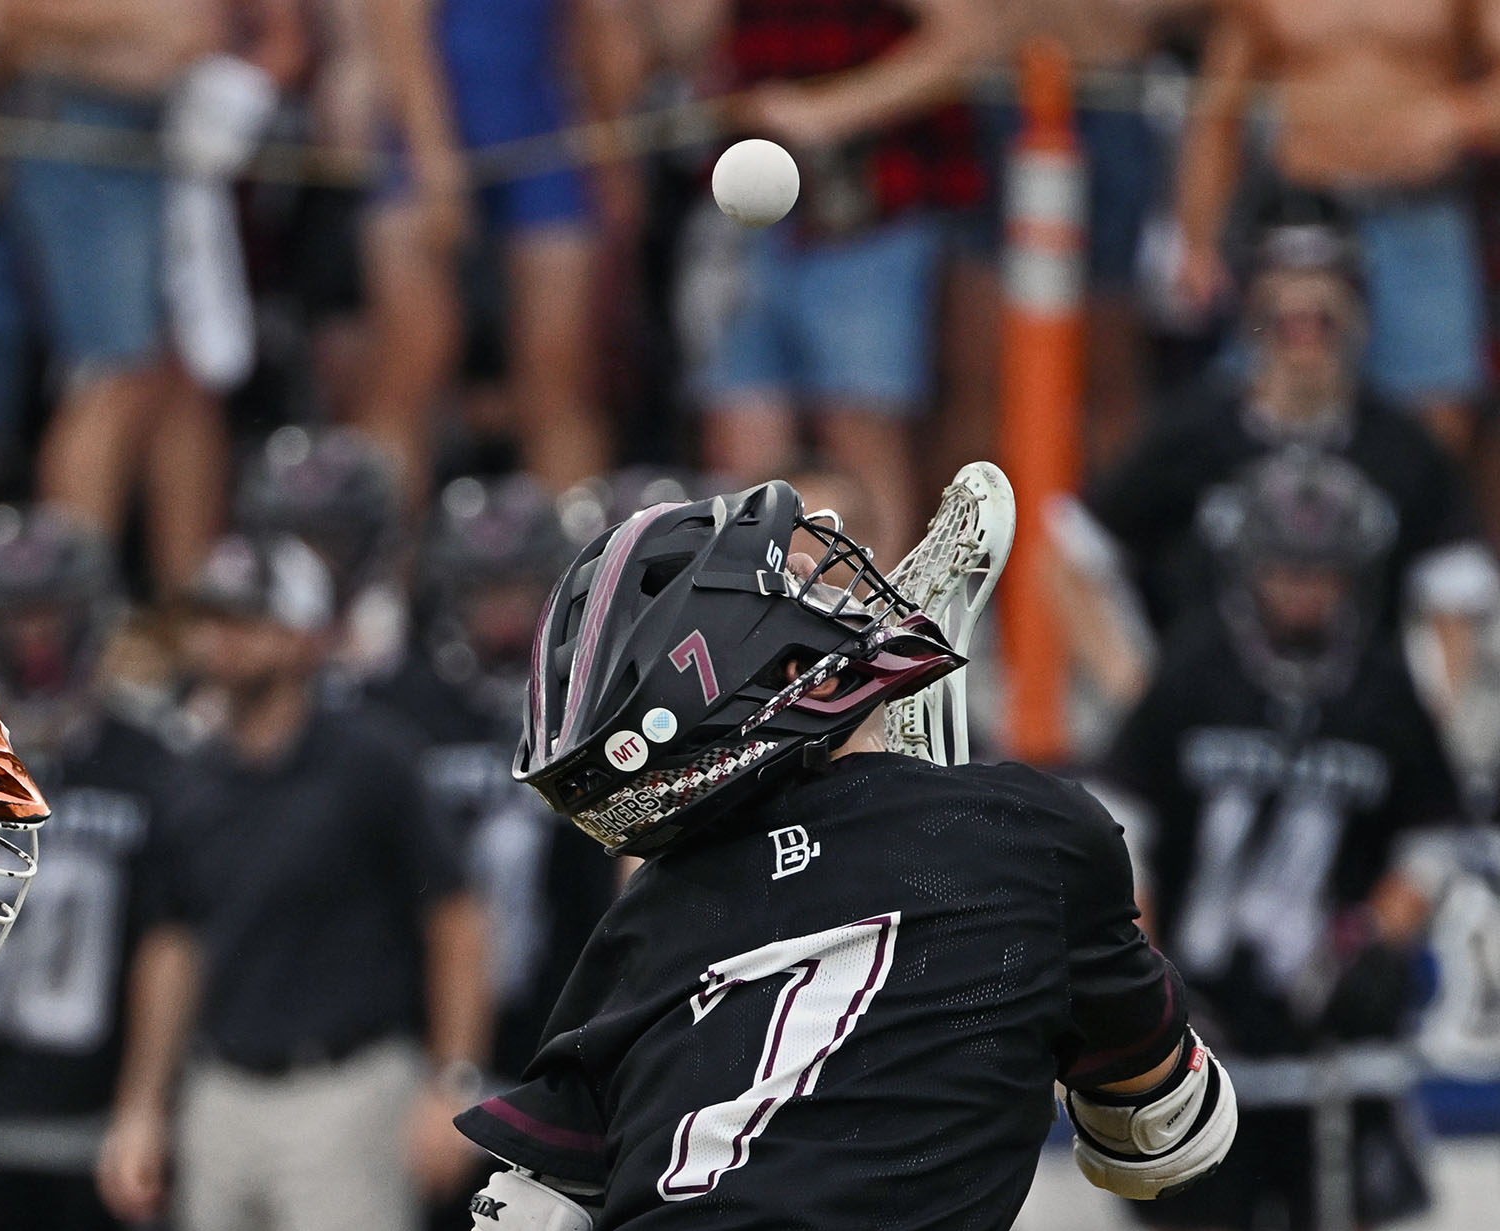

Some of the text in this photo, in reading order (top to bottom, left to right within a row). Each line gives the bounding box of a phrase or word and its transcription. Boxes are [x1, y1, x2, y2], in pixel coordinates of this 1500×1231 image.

[668, 629, 721, 707] 7
[611, 736, 641, 765] MT
[586, 789, 662, 842] LAKERS
[657, 910, 901, 1201] 7
